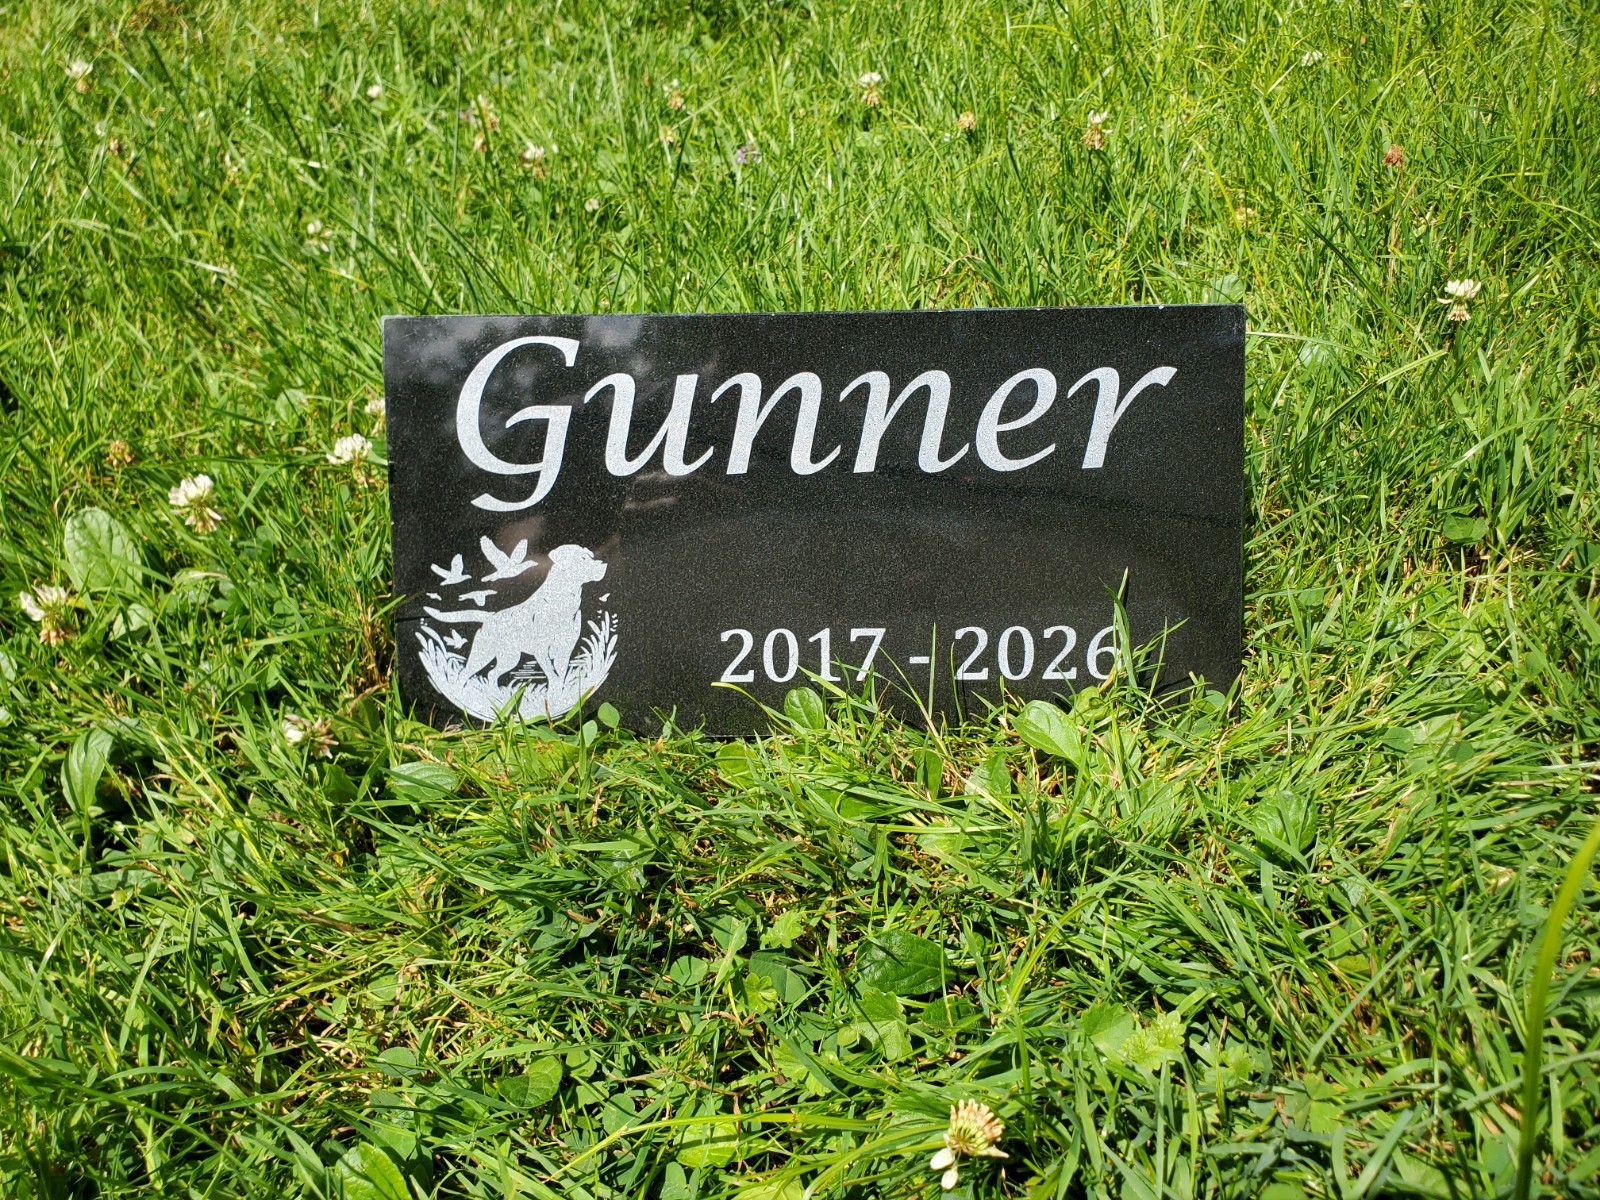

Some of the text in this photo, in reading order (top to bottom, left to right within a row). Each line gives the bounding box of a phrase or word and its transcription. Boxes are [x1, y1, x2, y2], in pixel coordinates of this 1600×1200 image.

[456, 335, 1178, 512] Gunner
[719, 625, 1124, 683] 2017 - 2026
